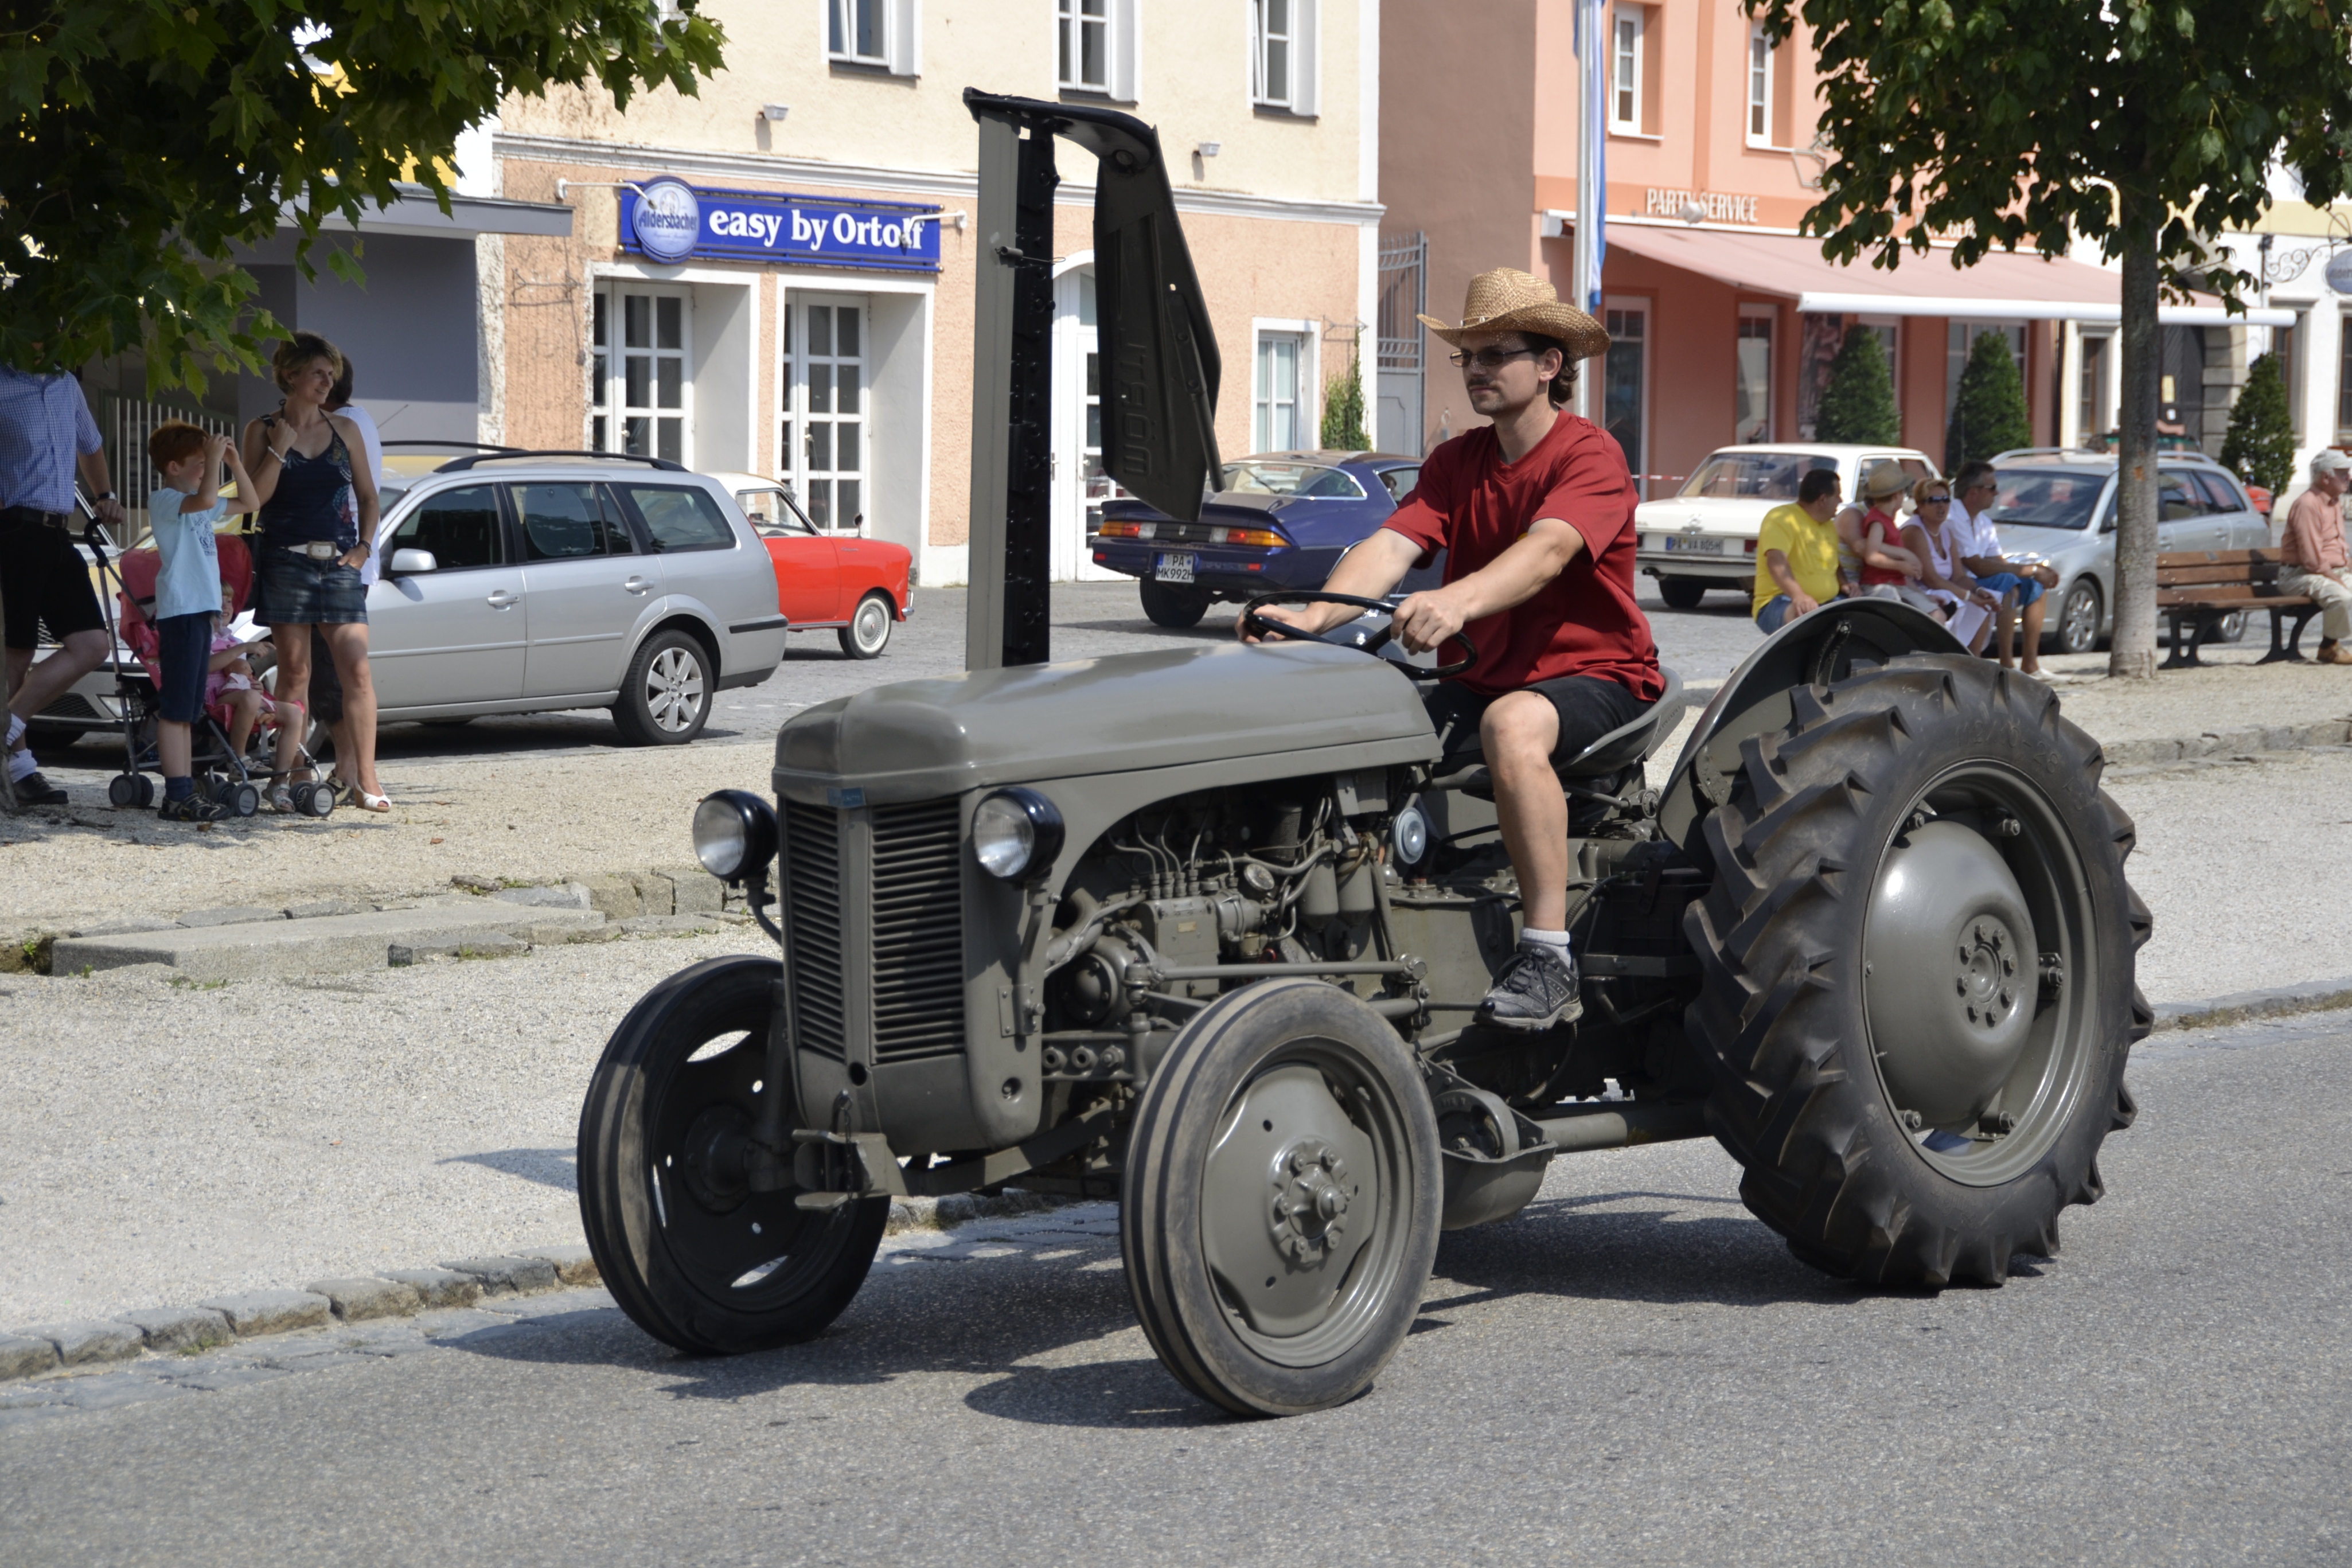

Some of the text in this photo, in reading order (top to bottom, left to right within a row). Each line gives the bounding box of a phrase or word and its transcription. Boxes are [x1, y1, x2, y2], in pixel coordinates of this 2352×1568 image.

[1699, 192, 1758, 223] SERVICE
[638, 209, 697, 231] Aldersbacher
[709, 209, 925, 252] easy by Ortolf
[1172, 555, 1184, 567] PA
[1156, 567, 1193, 580] MK992H
